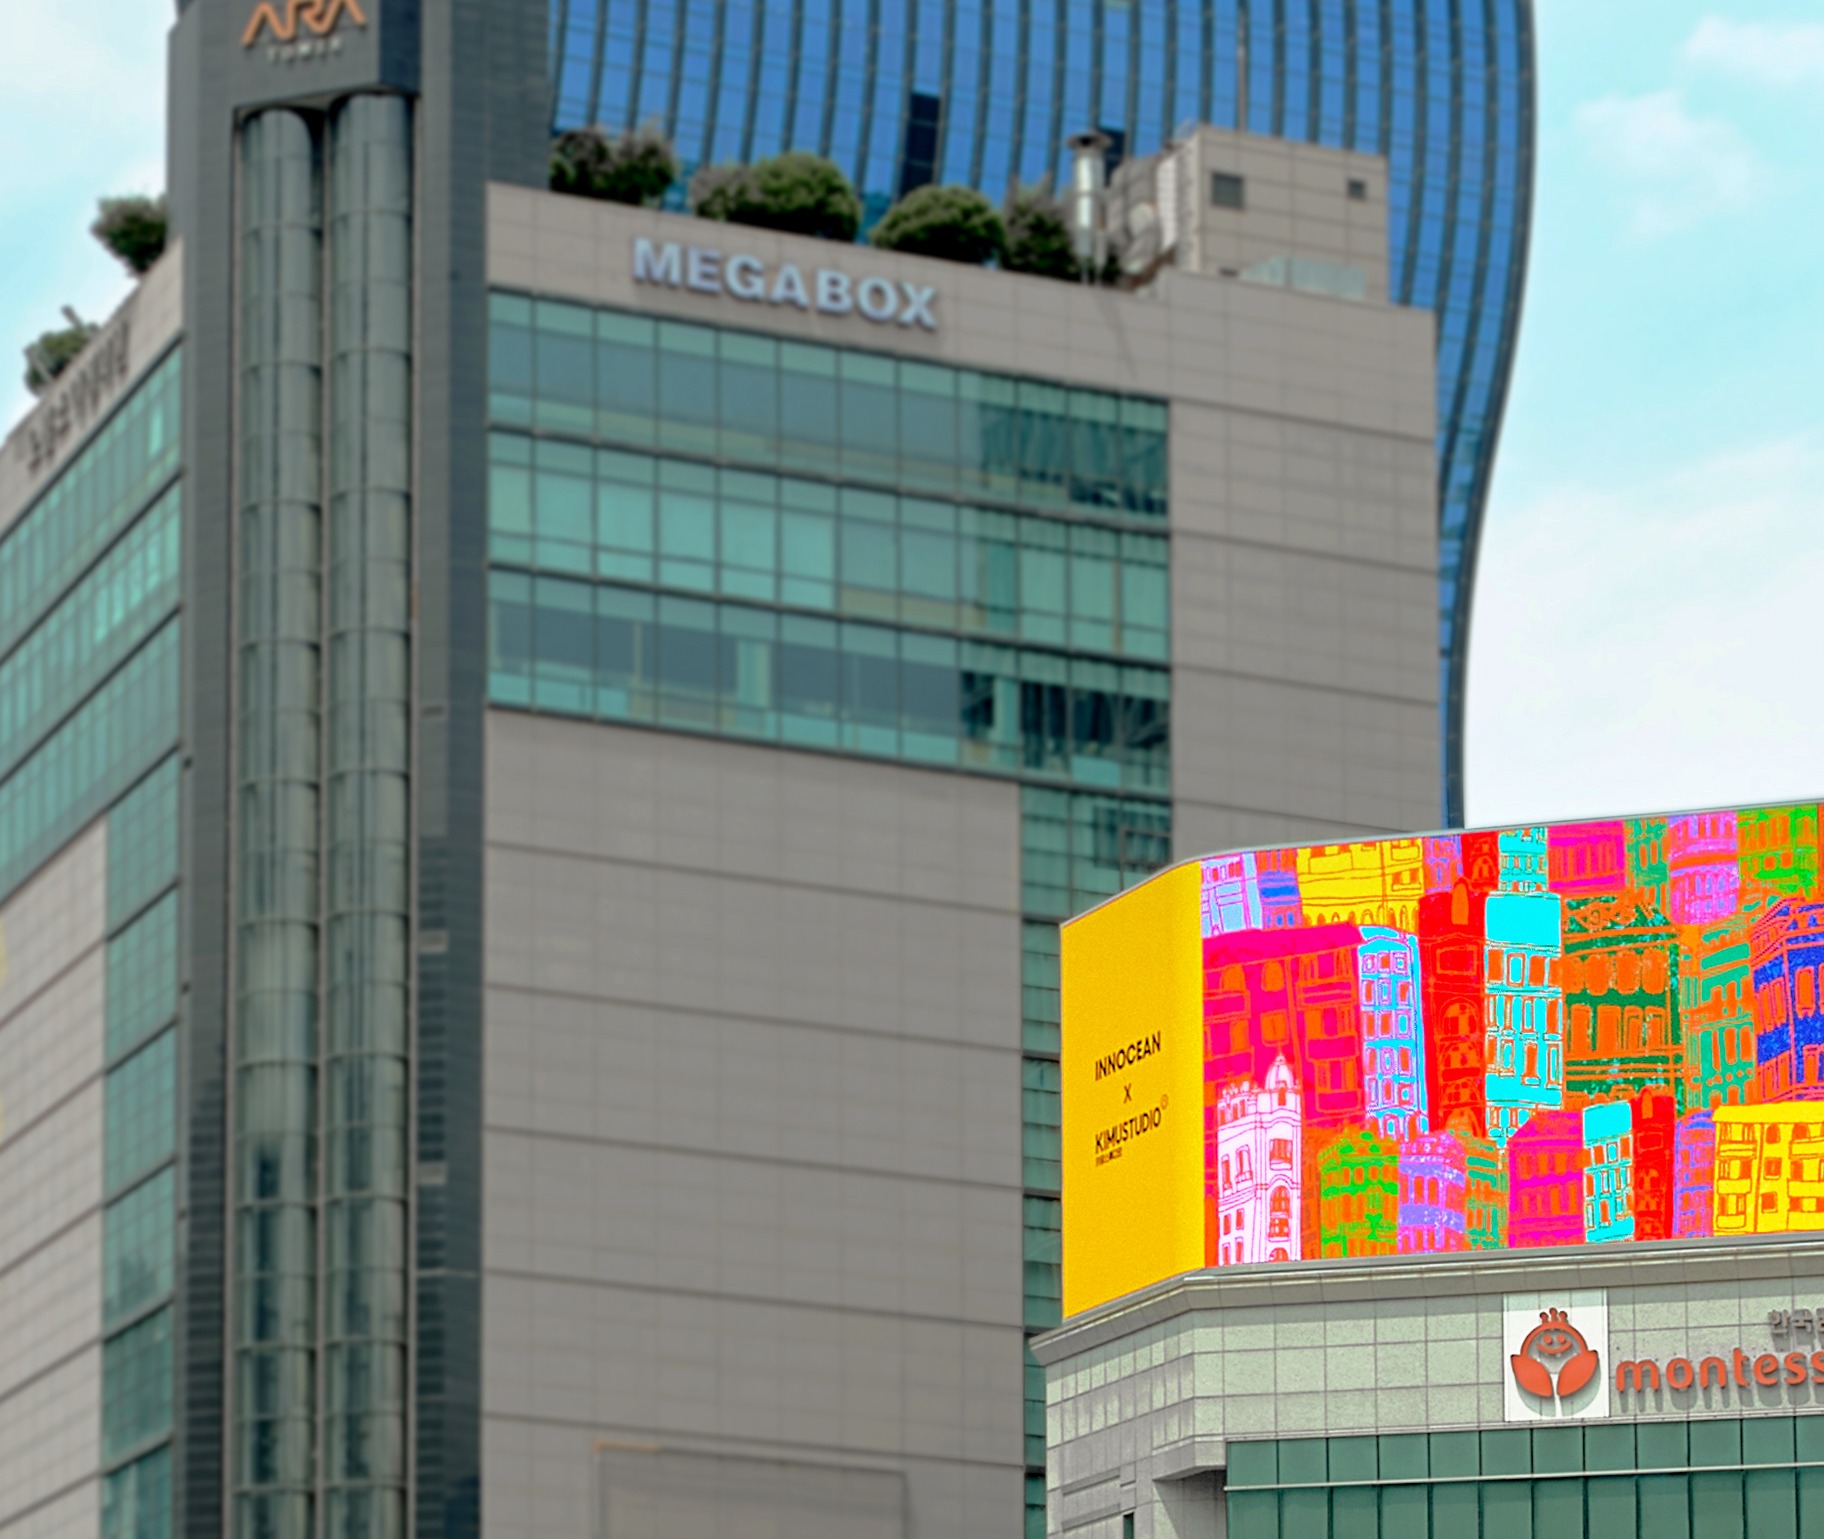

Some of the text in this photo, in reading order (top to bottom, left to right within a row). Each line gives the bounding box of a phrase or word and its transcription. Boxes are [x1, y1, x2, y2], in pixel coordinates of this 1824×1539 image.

[632, 236, 937, 330] MEGABOX
[1095, 1030, 1161, 1081] INNOCEAN
[1095, 1107, 1162, 1155] KIMUSTUDIO
